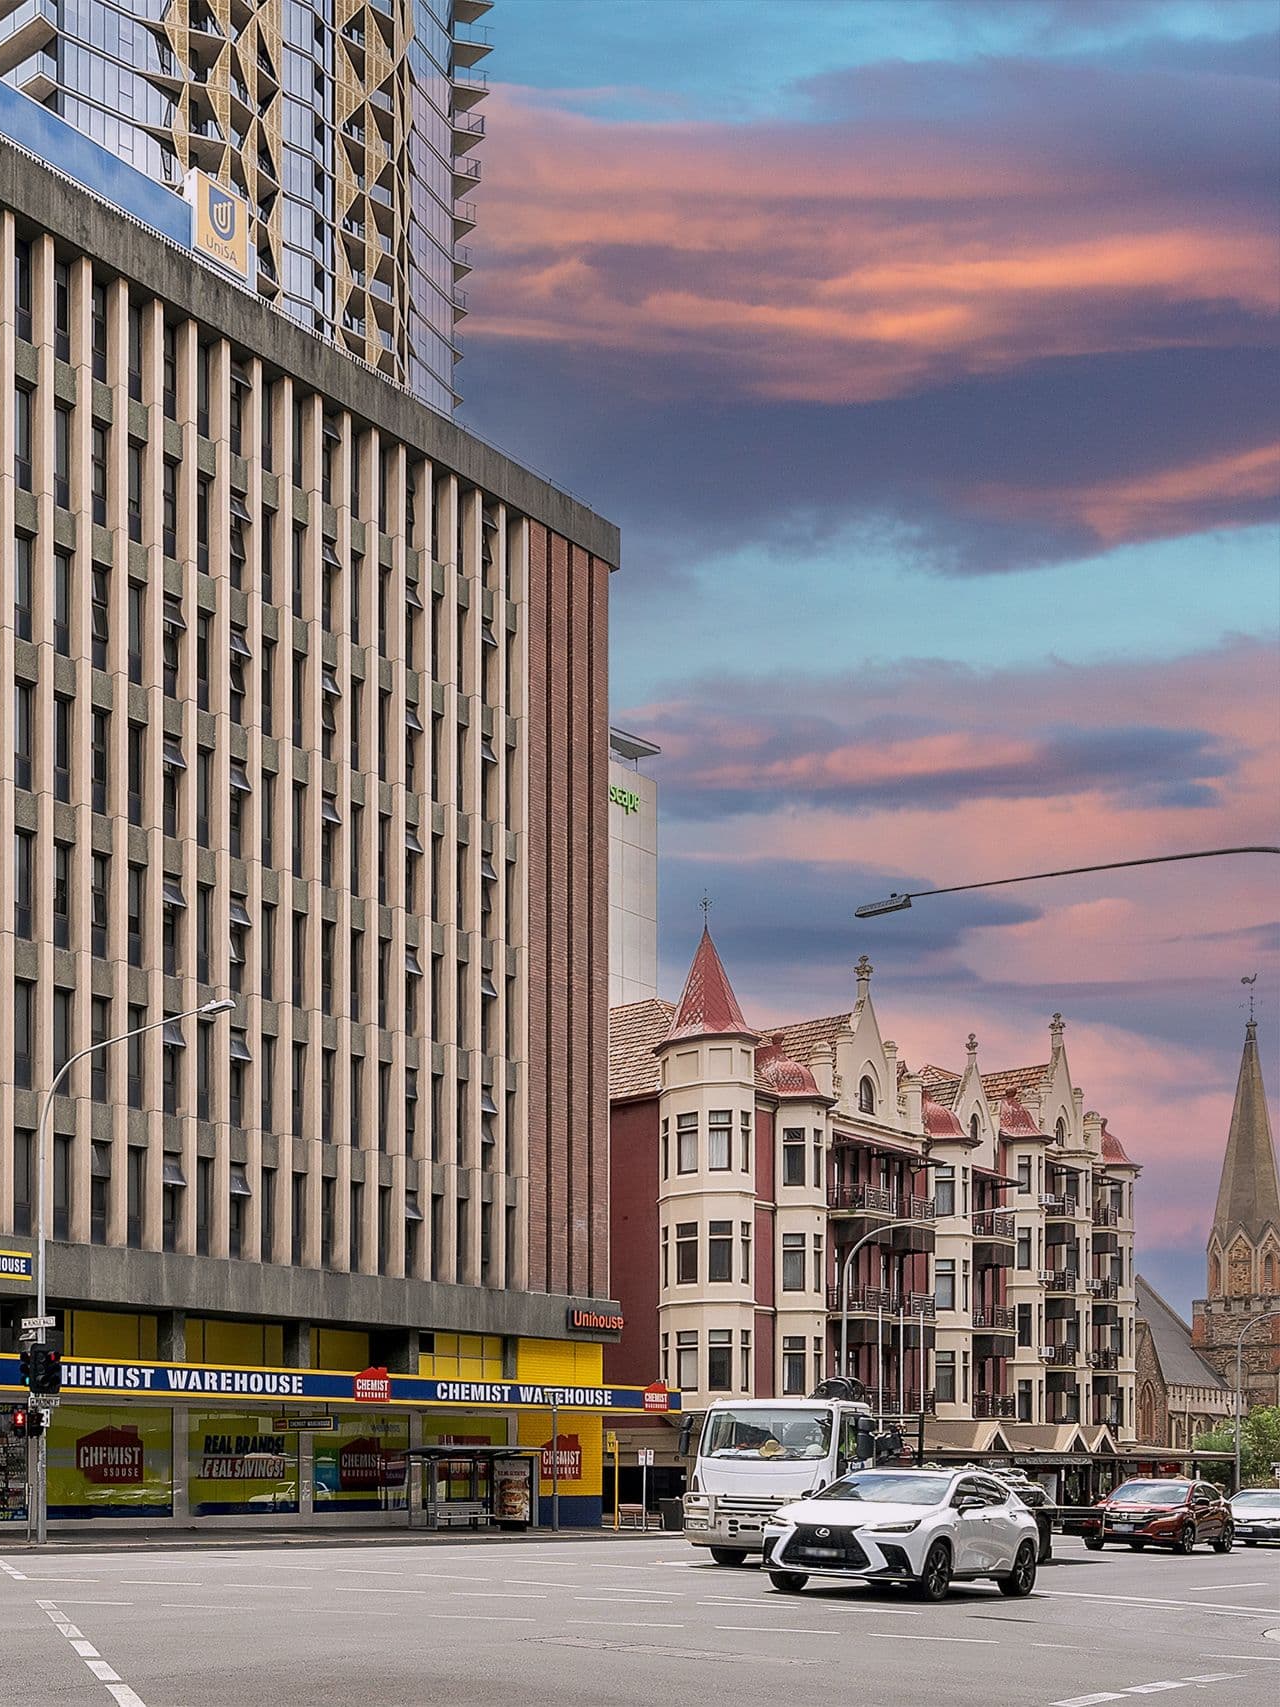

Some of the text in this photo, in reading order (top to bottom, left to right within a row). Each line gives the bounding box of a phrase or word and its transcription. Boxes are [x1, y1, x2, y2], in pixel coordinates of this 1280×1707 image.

[205, 234, 238, 265] UniSA
[573, 1310, 624, 1329] Unihouse
[61, 1364, 303, 1395] HEMIST WAREHOUSE
[356, 1378, 389, 1391] CHEMIST
[356, 1391, 388, 1399] WAREHOUSE
[436, 1382, 512, 1401] CHEMIST
[644, 1393, 668, 1403] CHEMIST
[204, 1435, 232, 1454] REAL
[342, 1453, 381, 1468] CHEMIST
[543, 1466, 580, 1475] WAEHOUSE
